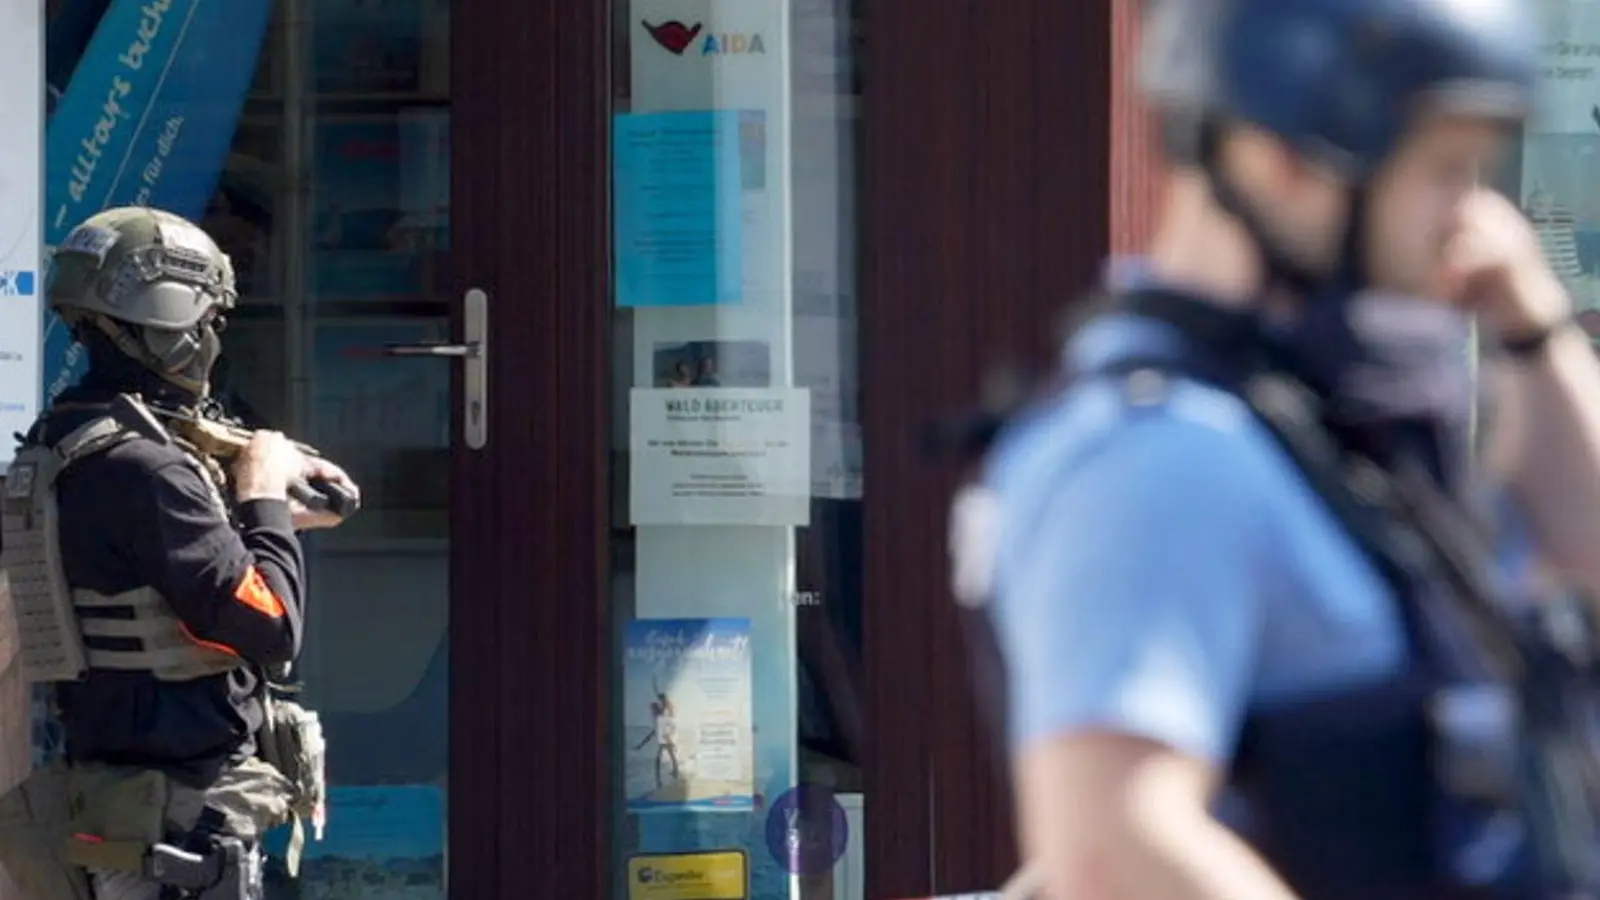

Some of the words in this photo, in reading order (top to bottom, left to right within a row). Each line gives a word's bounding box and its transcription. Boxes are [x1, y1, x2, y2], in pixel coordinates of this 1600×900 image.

[702, 33, 766, 56] AIDA
[68, 75, 132, 203] alltours
[118, 0, 171, 70] buch
